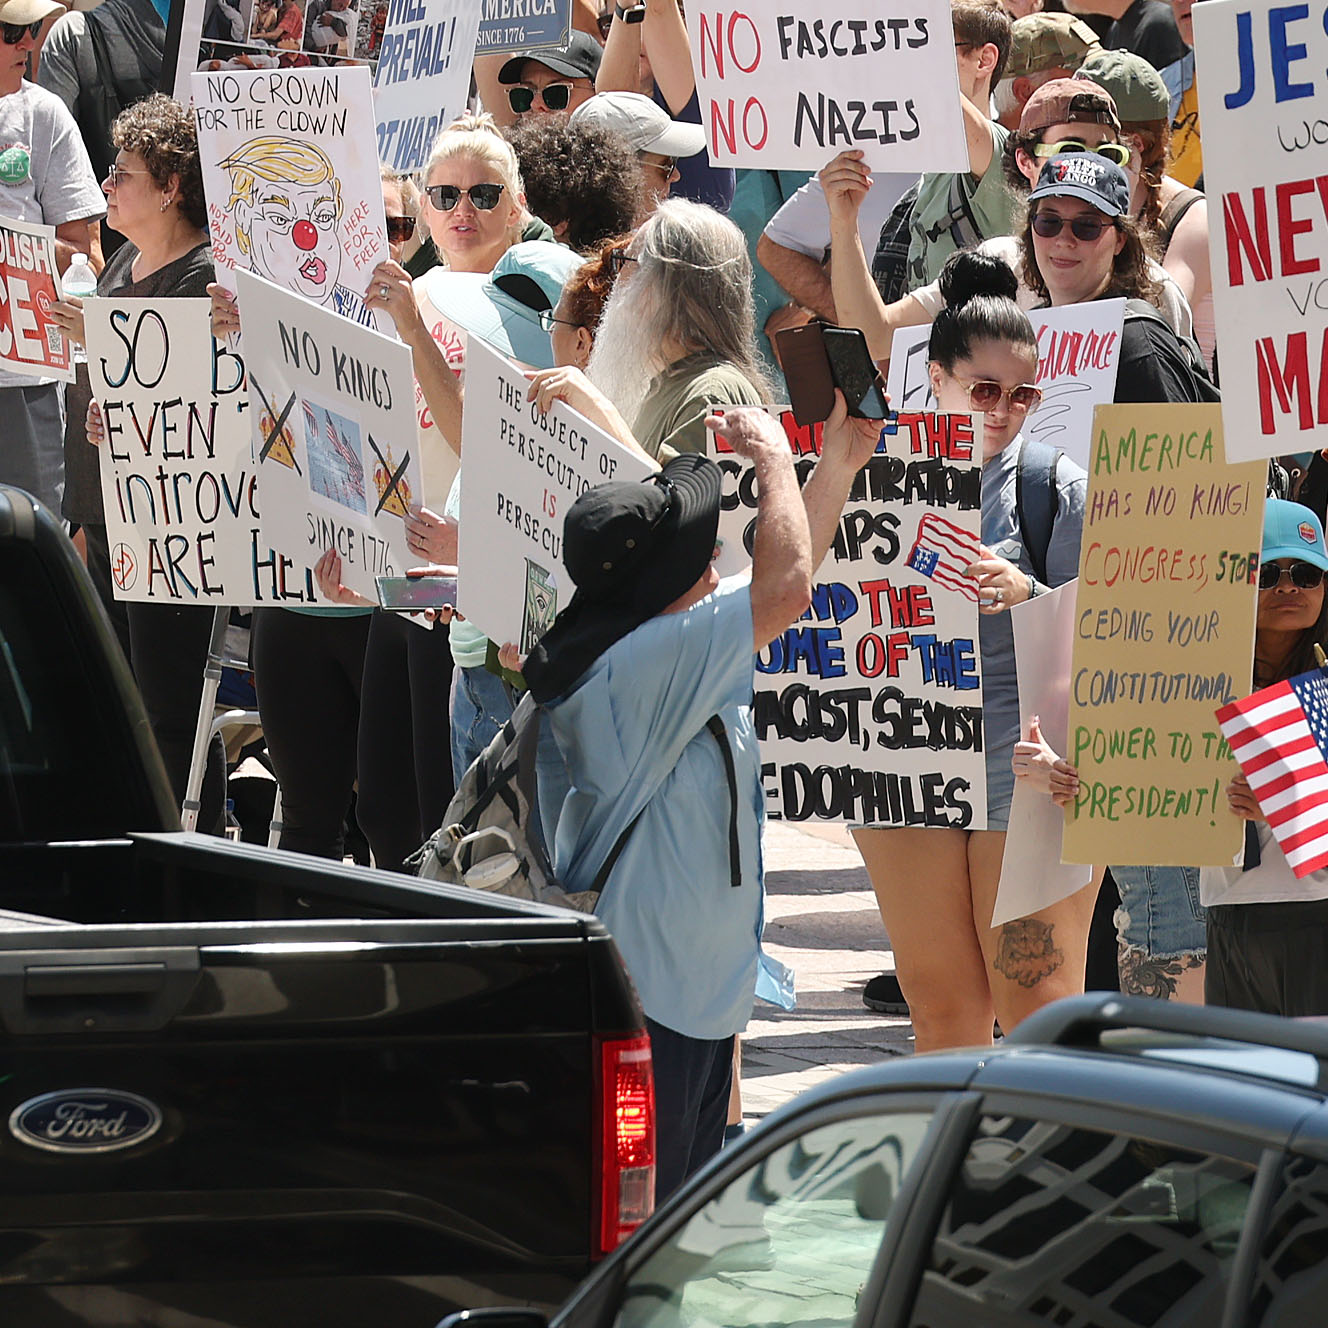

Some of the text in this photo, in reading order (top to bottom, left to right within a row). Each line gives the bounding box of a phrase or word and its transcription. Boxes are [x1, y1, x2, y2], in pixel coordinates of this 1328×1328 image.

[698, 10, 929, 79] NO FASCISTS
[710, 91, 921, 158] NO NAZIS
[1095, 428, 1213, 476] AMERICA
[1089, 482, 1249, 526] HAS NO KING!
[1083, 544, 1210, 594] CONGRESS,
[1080, 608, 1220, 646] CEDING YOUR
[1075, 669, 1236, 705] CONSTITUTIONAL
[1075, 727, 1156, 765] POWER
[1169, 733, 1192, 761] TO
[1074, 777, 1220, 828] PRESIDENT!
[50, 1101, 132, 1142] Ford
